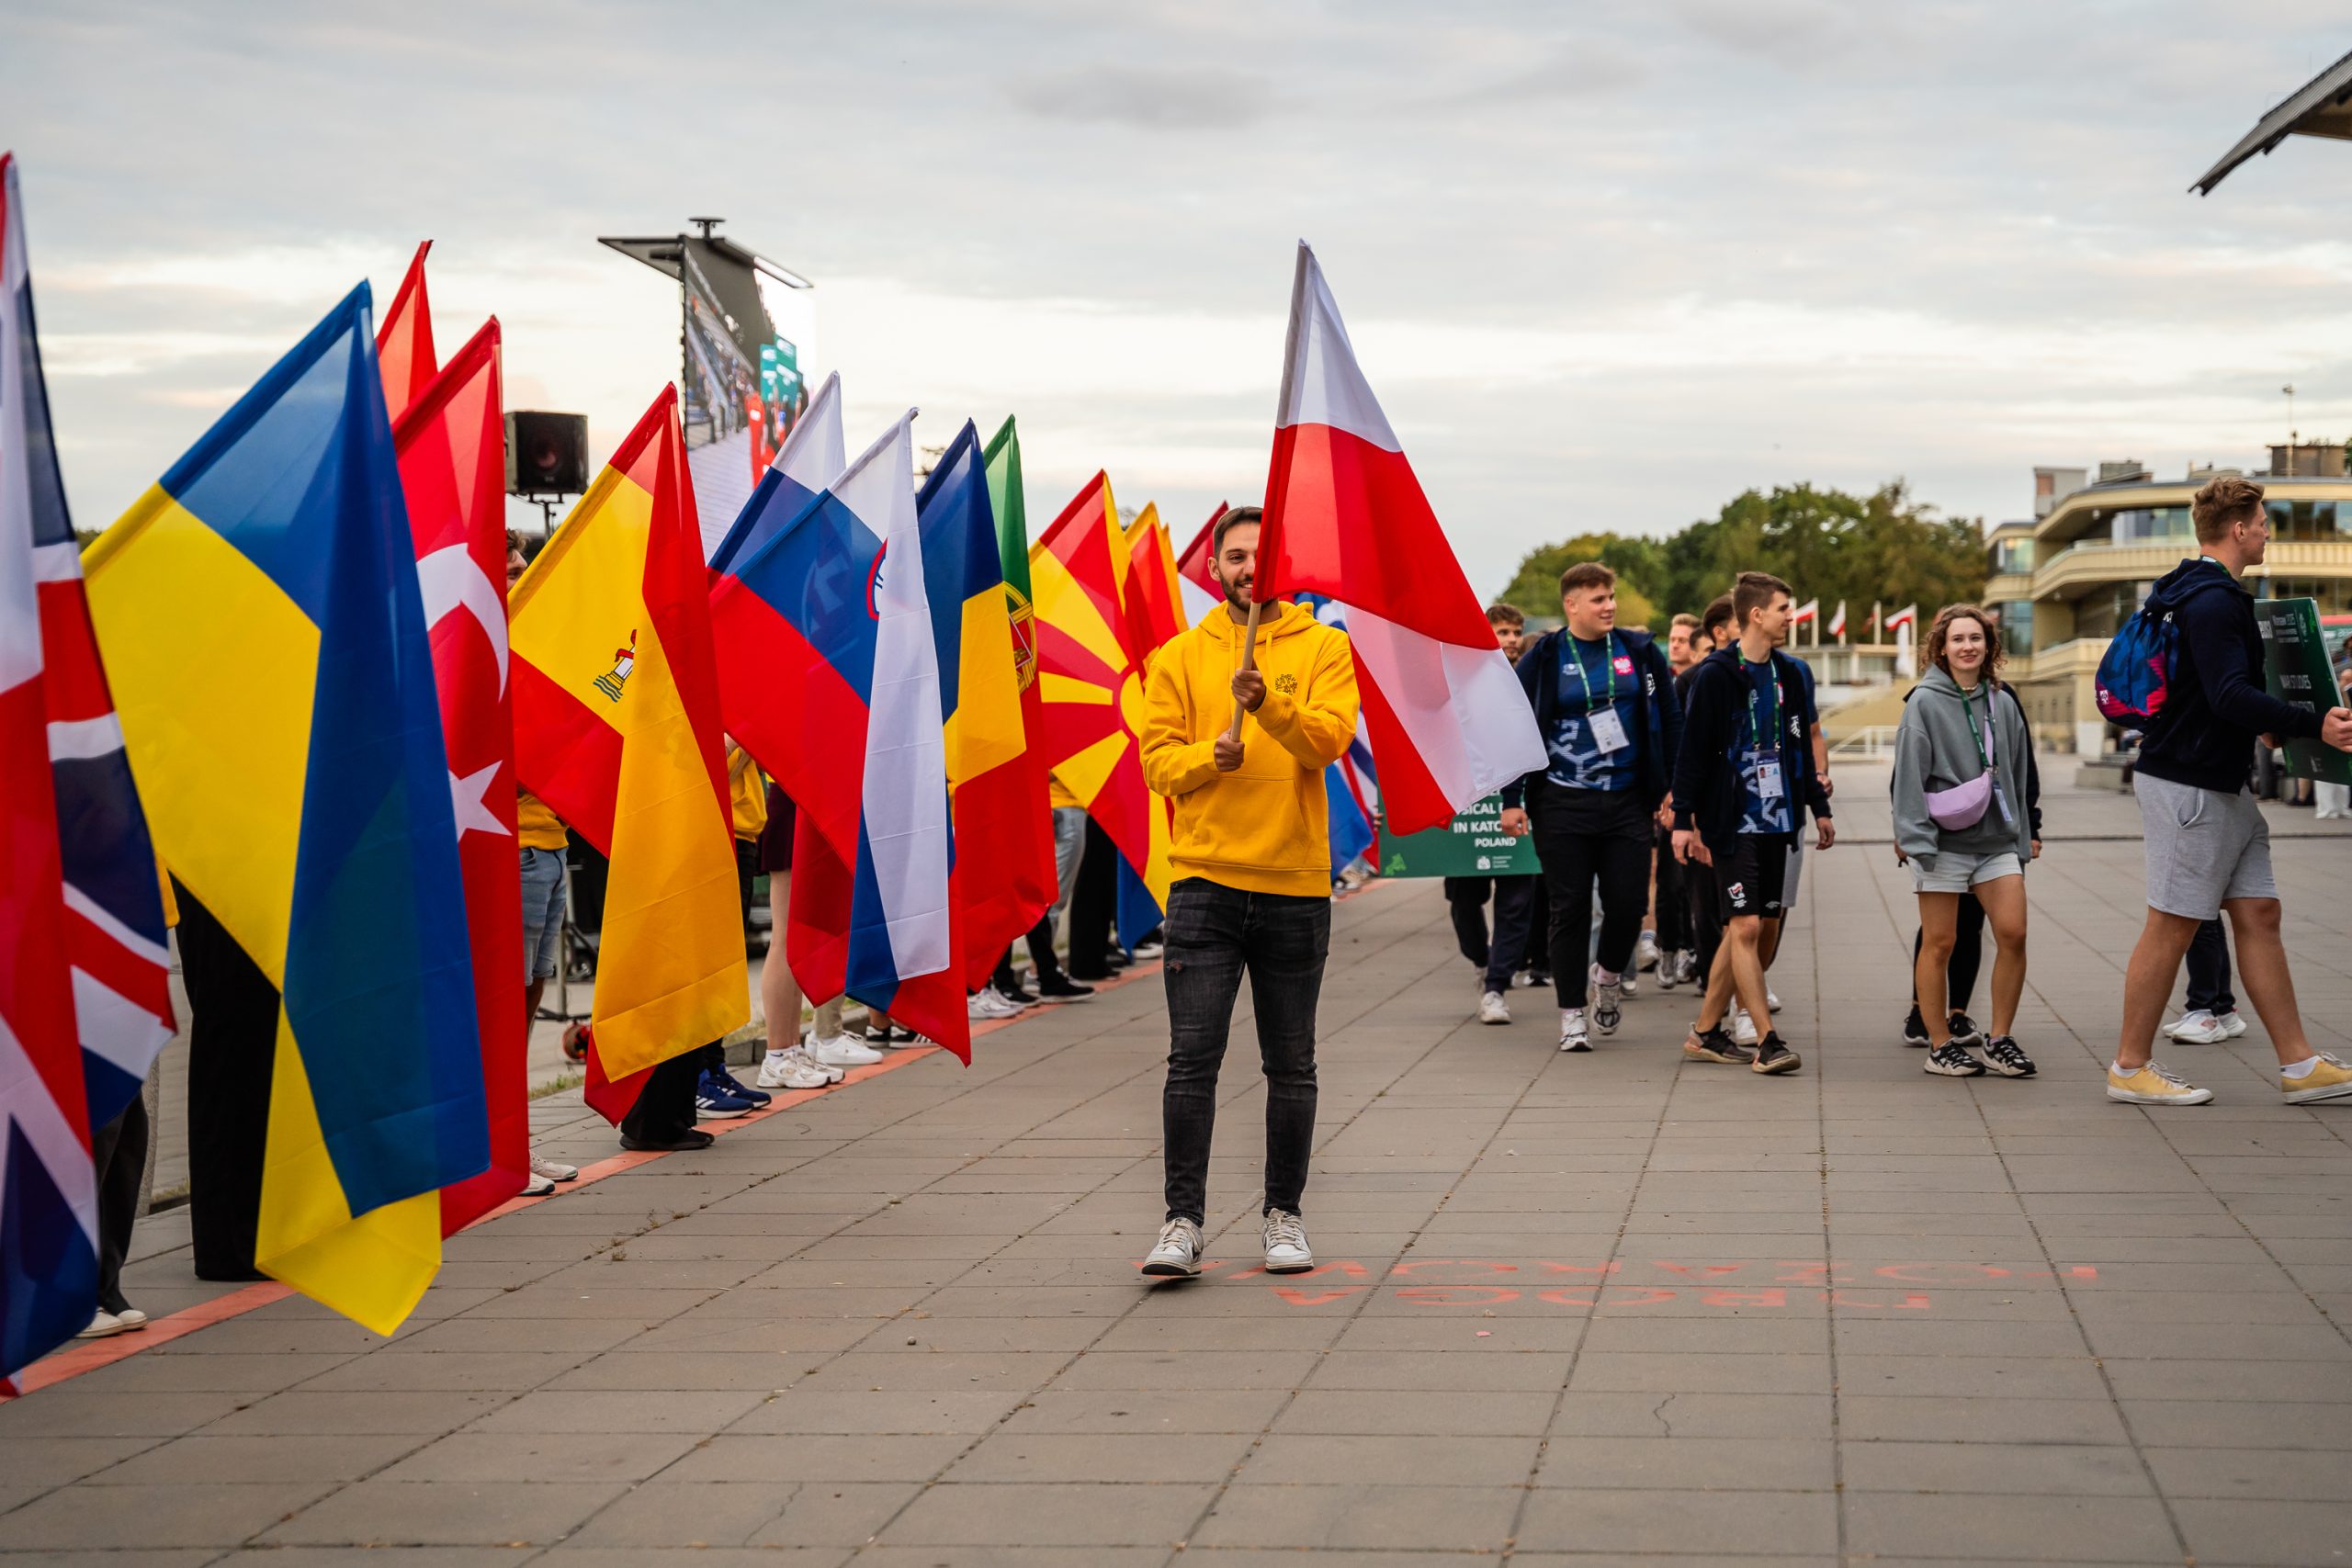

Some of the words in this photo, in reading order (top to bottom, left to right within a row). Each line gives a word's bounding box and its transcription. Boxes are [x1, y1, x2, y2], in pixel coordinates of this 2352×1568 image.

[1462, 803, 1496, 815] SICAL
[1454, 823, 1467, 833] IN
[1474, 837, 1517, 848] POLAND
